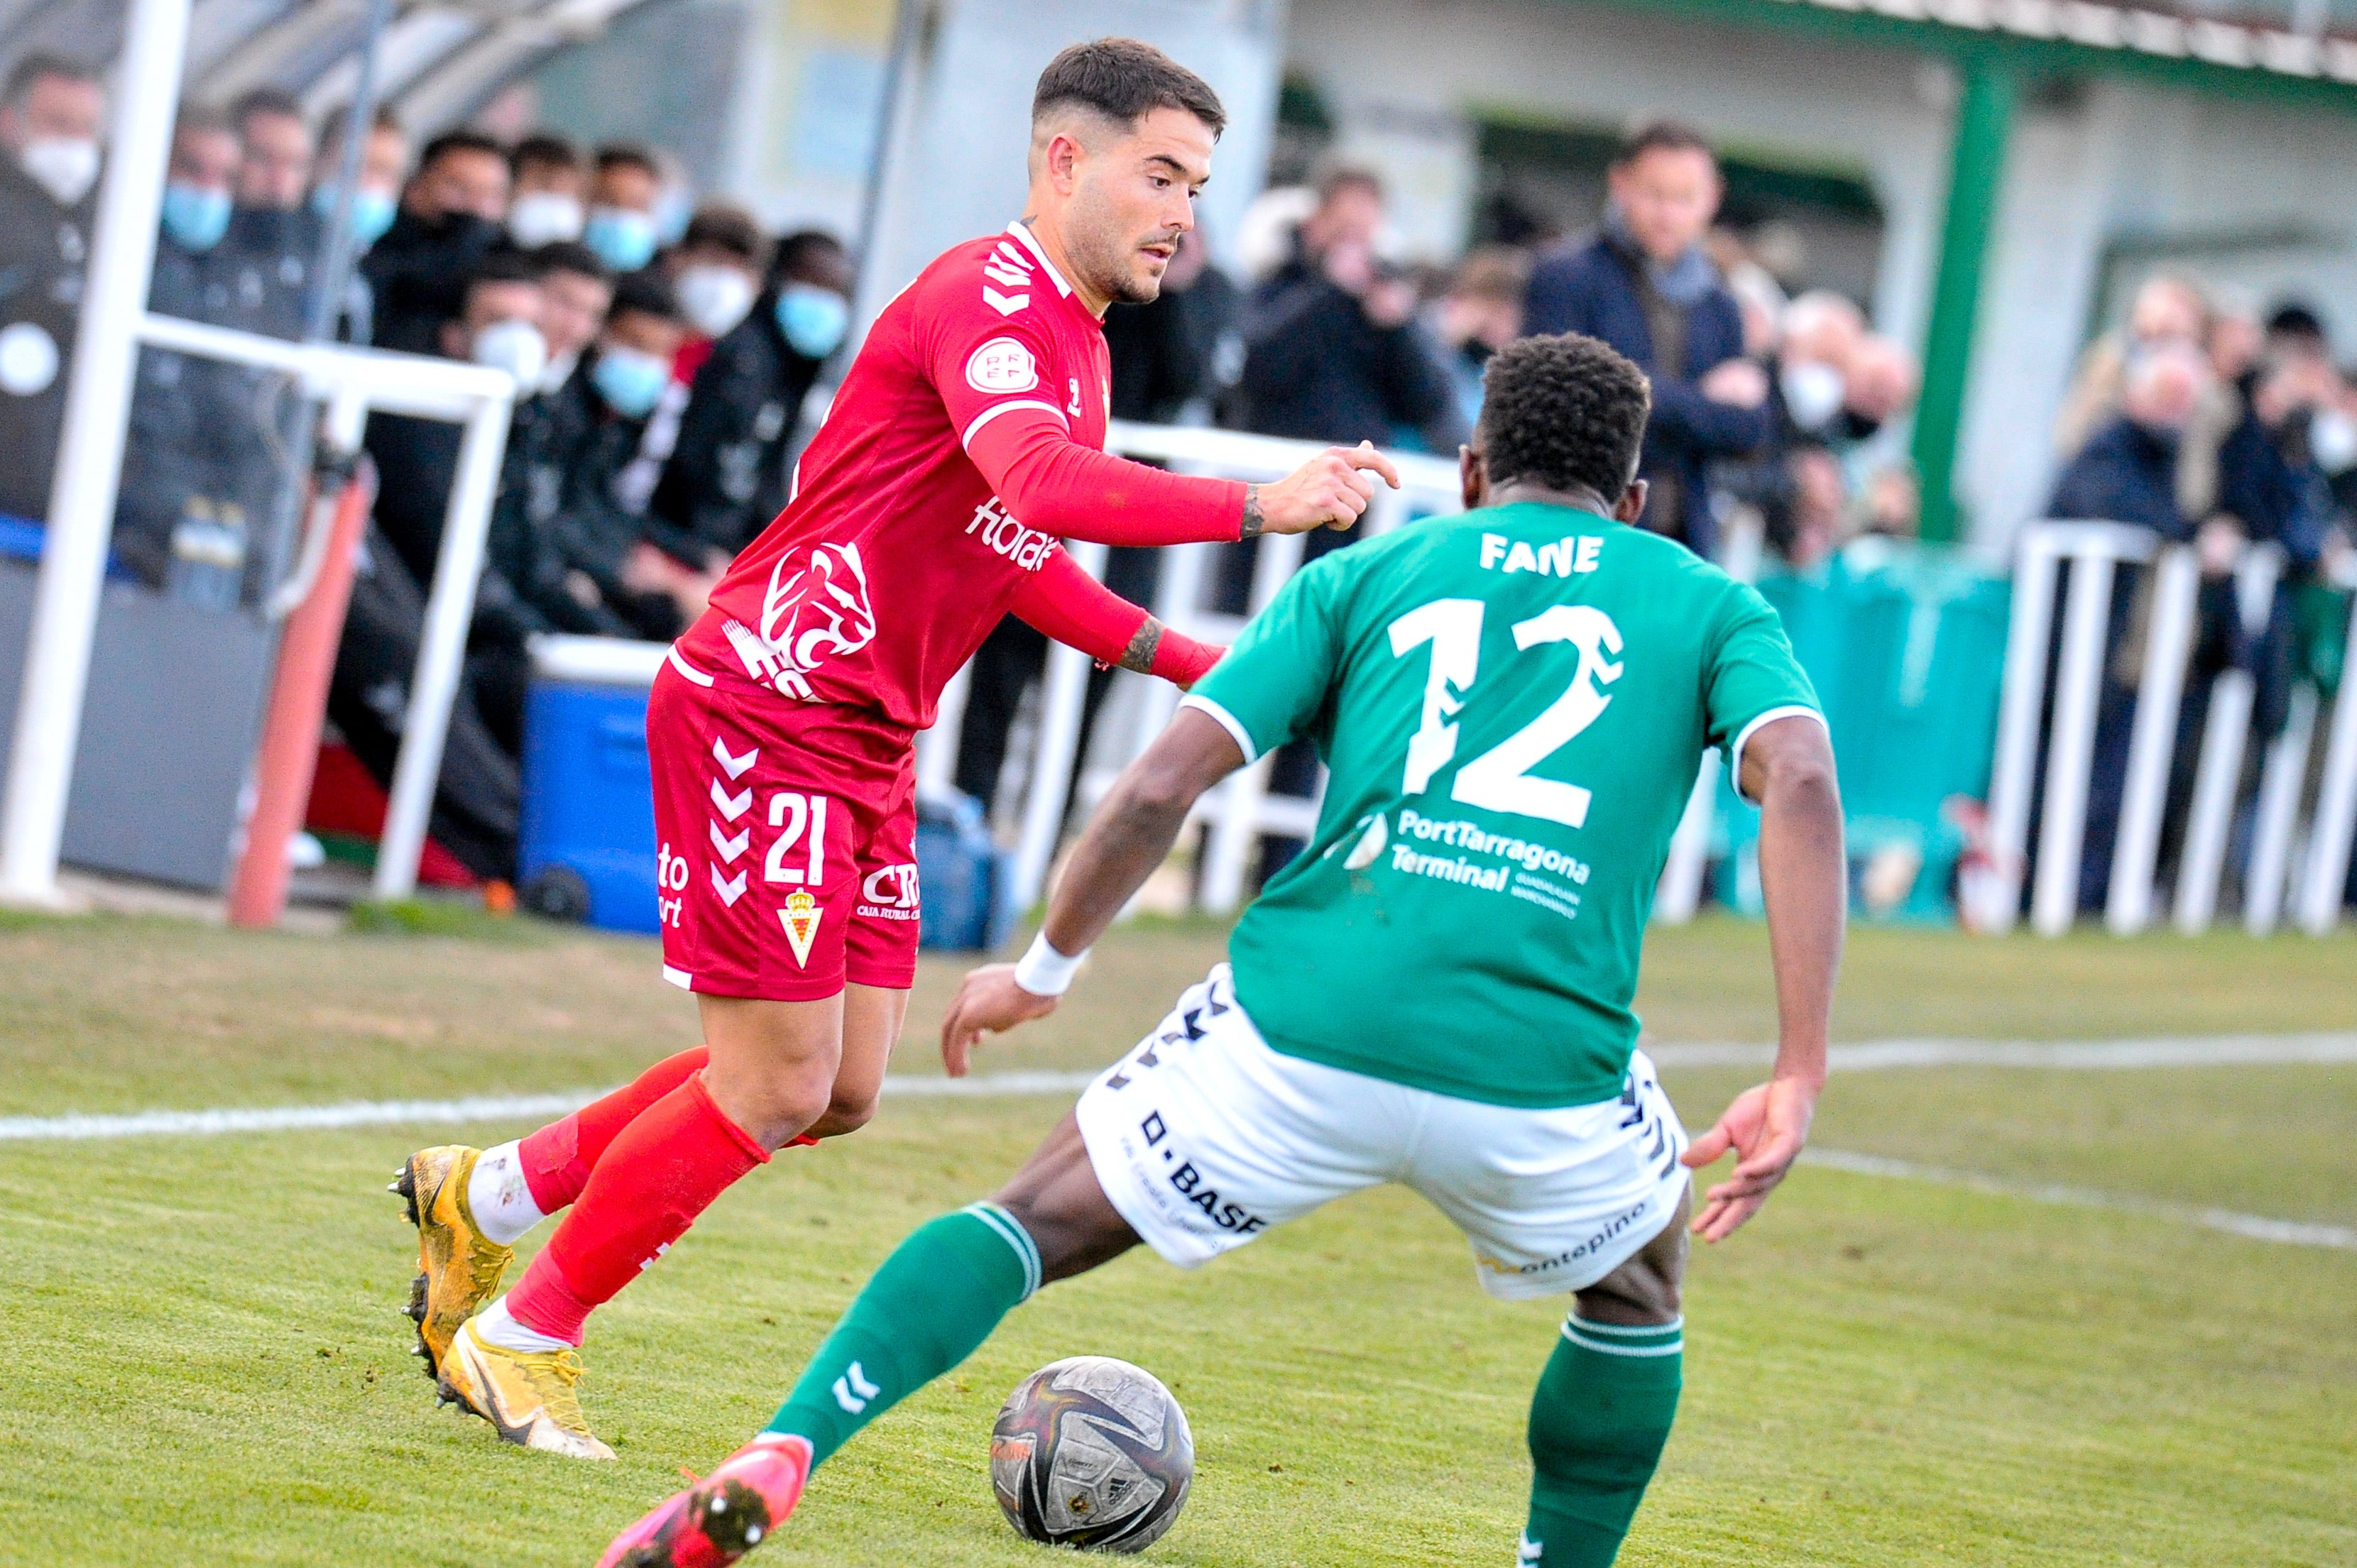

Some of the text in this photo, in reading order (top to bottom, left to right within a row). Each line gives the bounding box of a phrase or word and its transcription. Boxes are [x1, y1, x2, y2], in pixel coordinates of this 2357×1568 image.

[1480, 532, 1604, 578] FANE
[1387, 598, 1624, 830] 12
[764, 792, 827, 886] 21
[863, 863, 920, 908] CR
[1391, 843, 1511, 892] Terminal
[880, 908, 911, 920] RURAL
[1170, 1162, 1267, 1234] BASF
